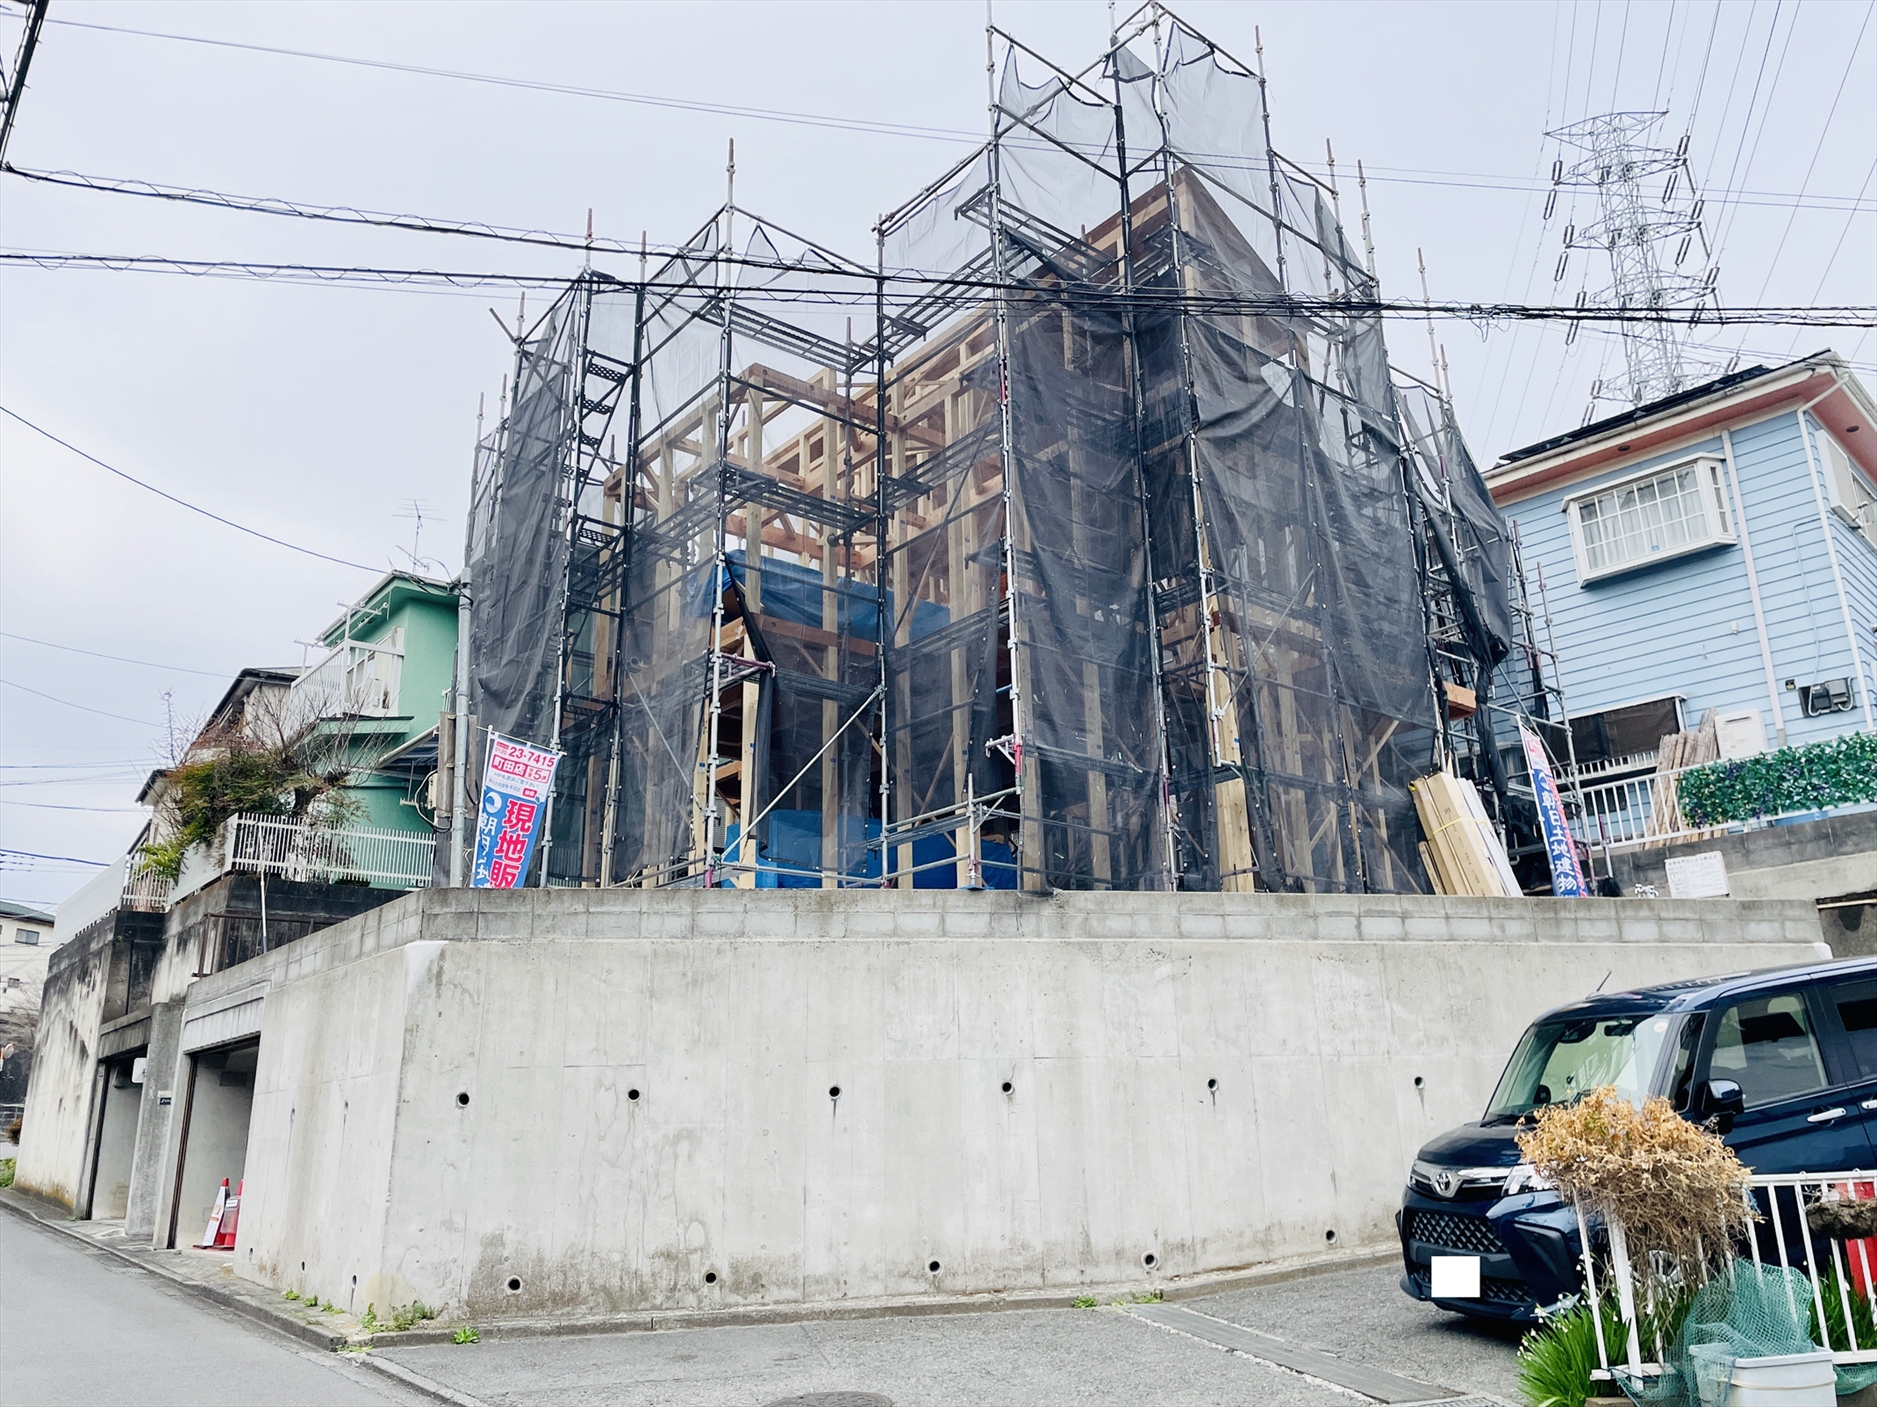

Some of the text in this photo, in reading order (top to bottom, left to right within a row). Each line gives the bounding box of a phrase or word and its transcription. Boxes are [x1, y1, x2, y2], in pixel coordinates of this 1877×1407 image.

[493, 755, 526, 776] 町田店
[1542, 791, 1577, 893] 朝日土地建物
